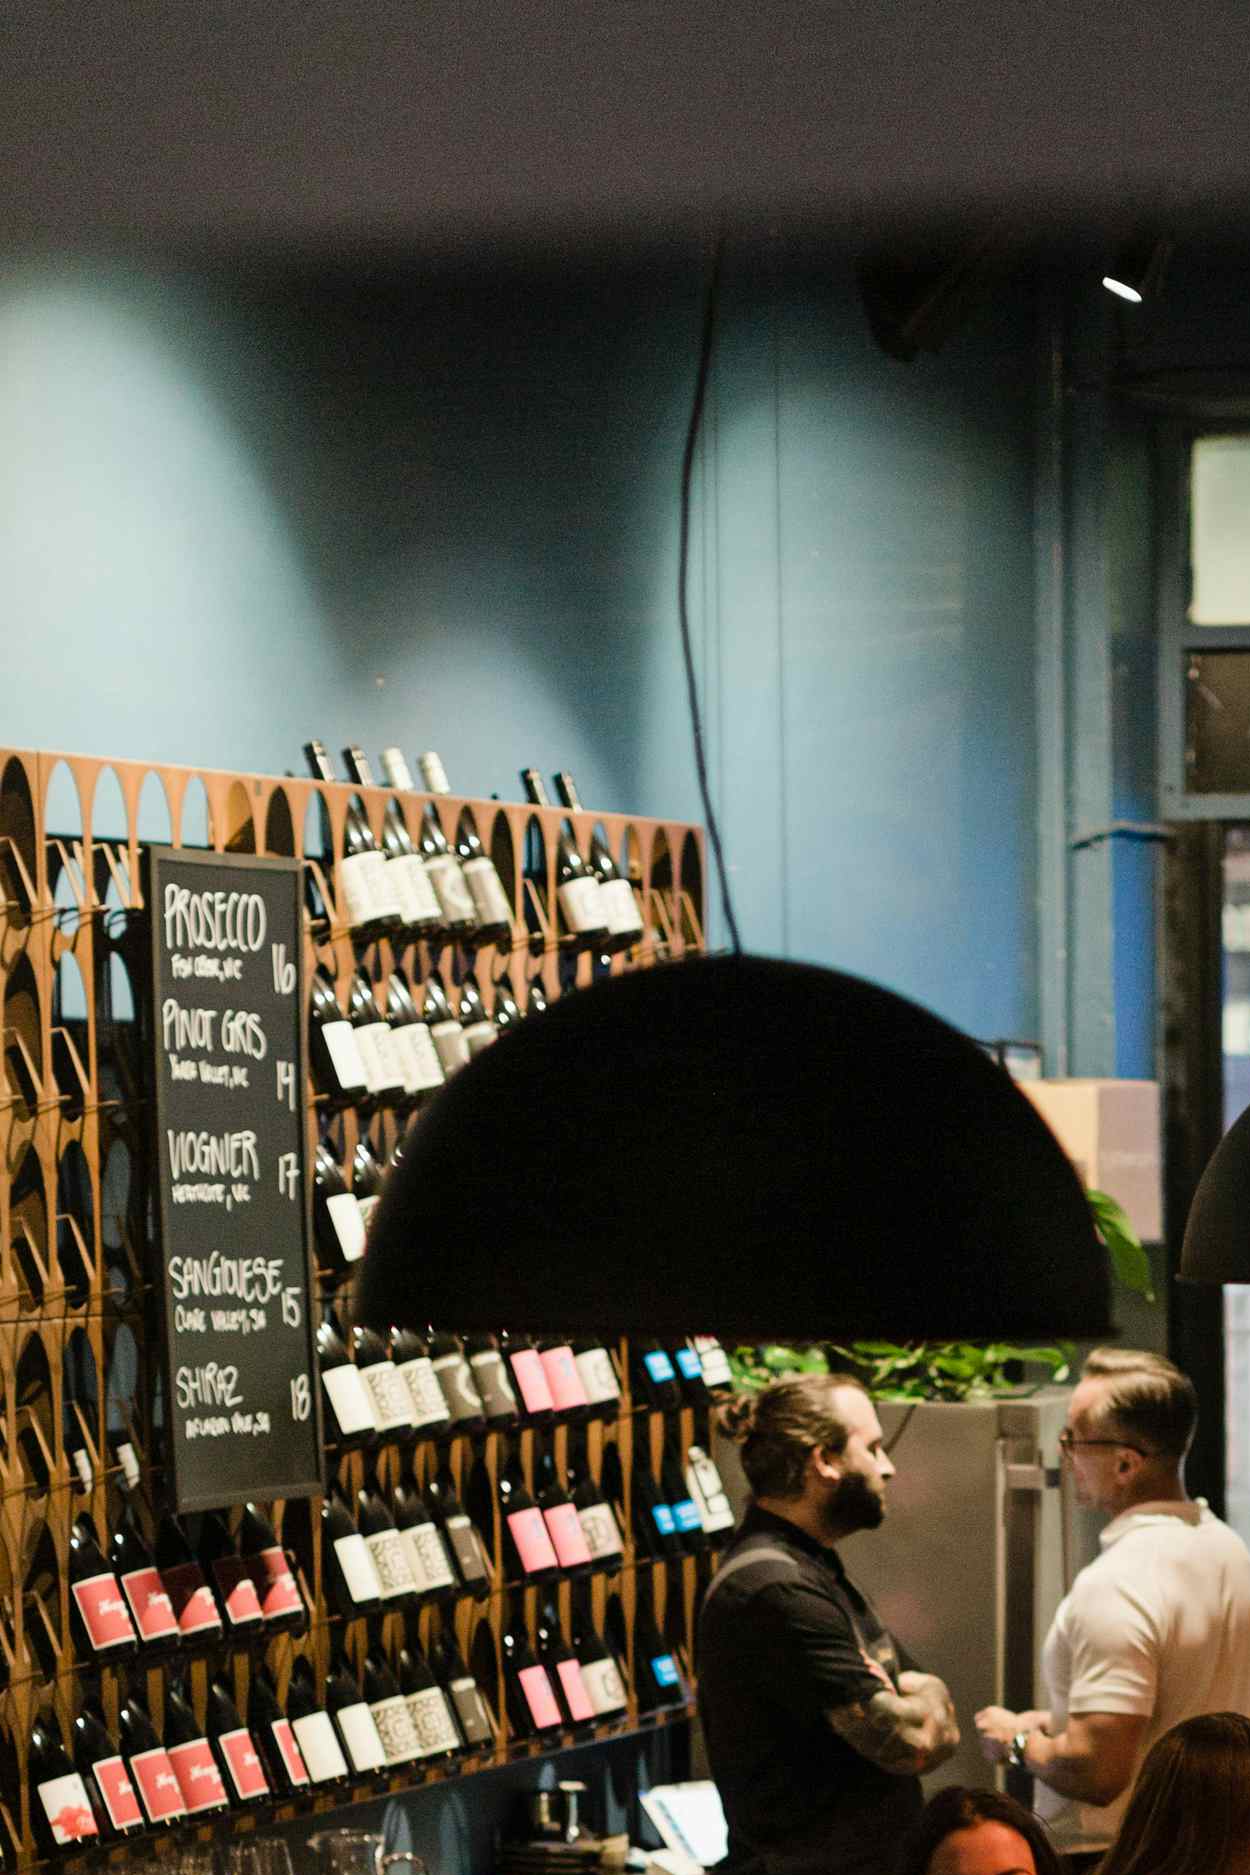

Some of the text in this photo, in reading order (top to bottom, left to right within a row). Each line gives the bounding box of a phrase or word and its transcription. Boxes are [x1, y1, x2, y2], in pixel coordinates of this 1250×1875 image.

[164, 884, 266, 951] PROSECCO
[272, 943, 296, 994] 16
[163, 999, 267, 1060] PINOT GRIS
[276, 1060, 296, 1112] 14
[167, 1129, 260, 1181] VIOGNIER
[278, 1152, 300, 1201] 17
[168, 1250, 284, 1304] SANGIOVESE
[281, 1287, 302, 1328] 15
[176, 1361, 244, 1408] SHIRAZ
[290, 1373, 312, 1421] 18
